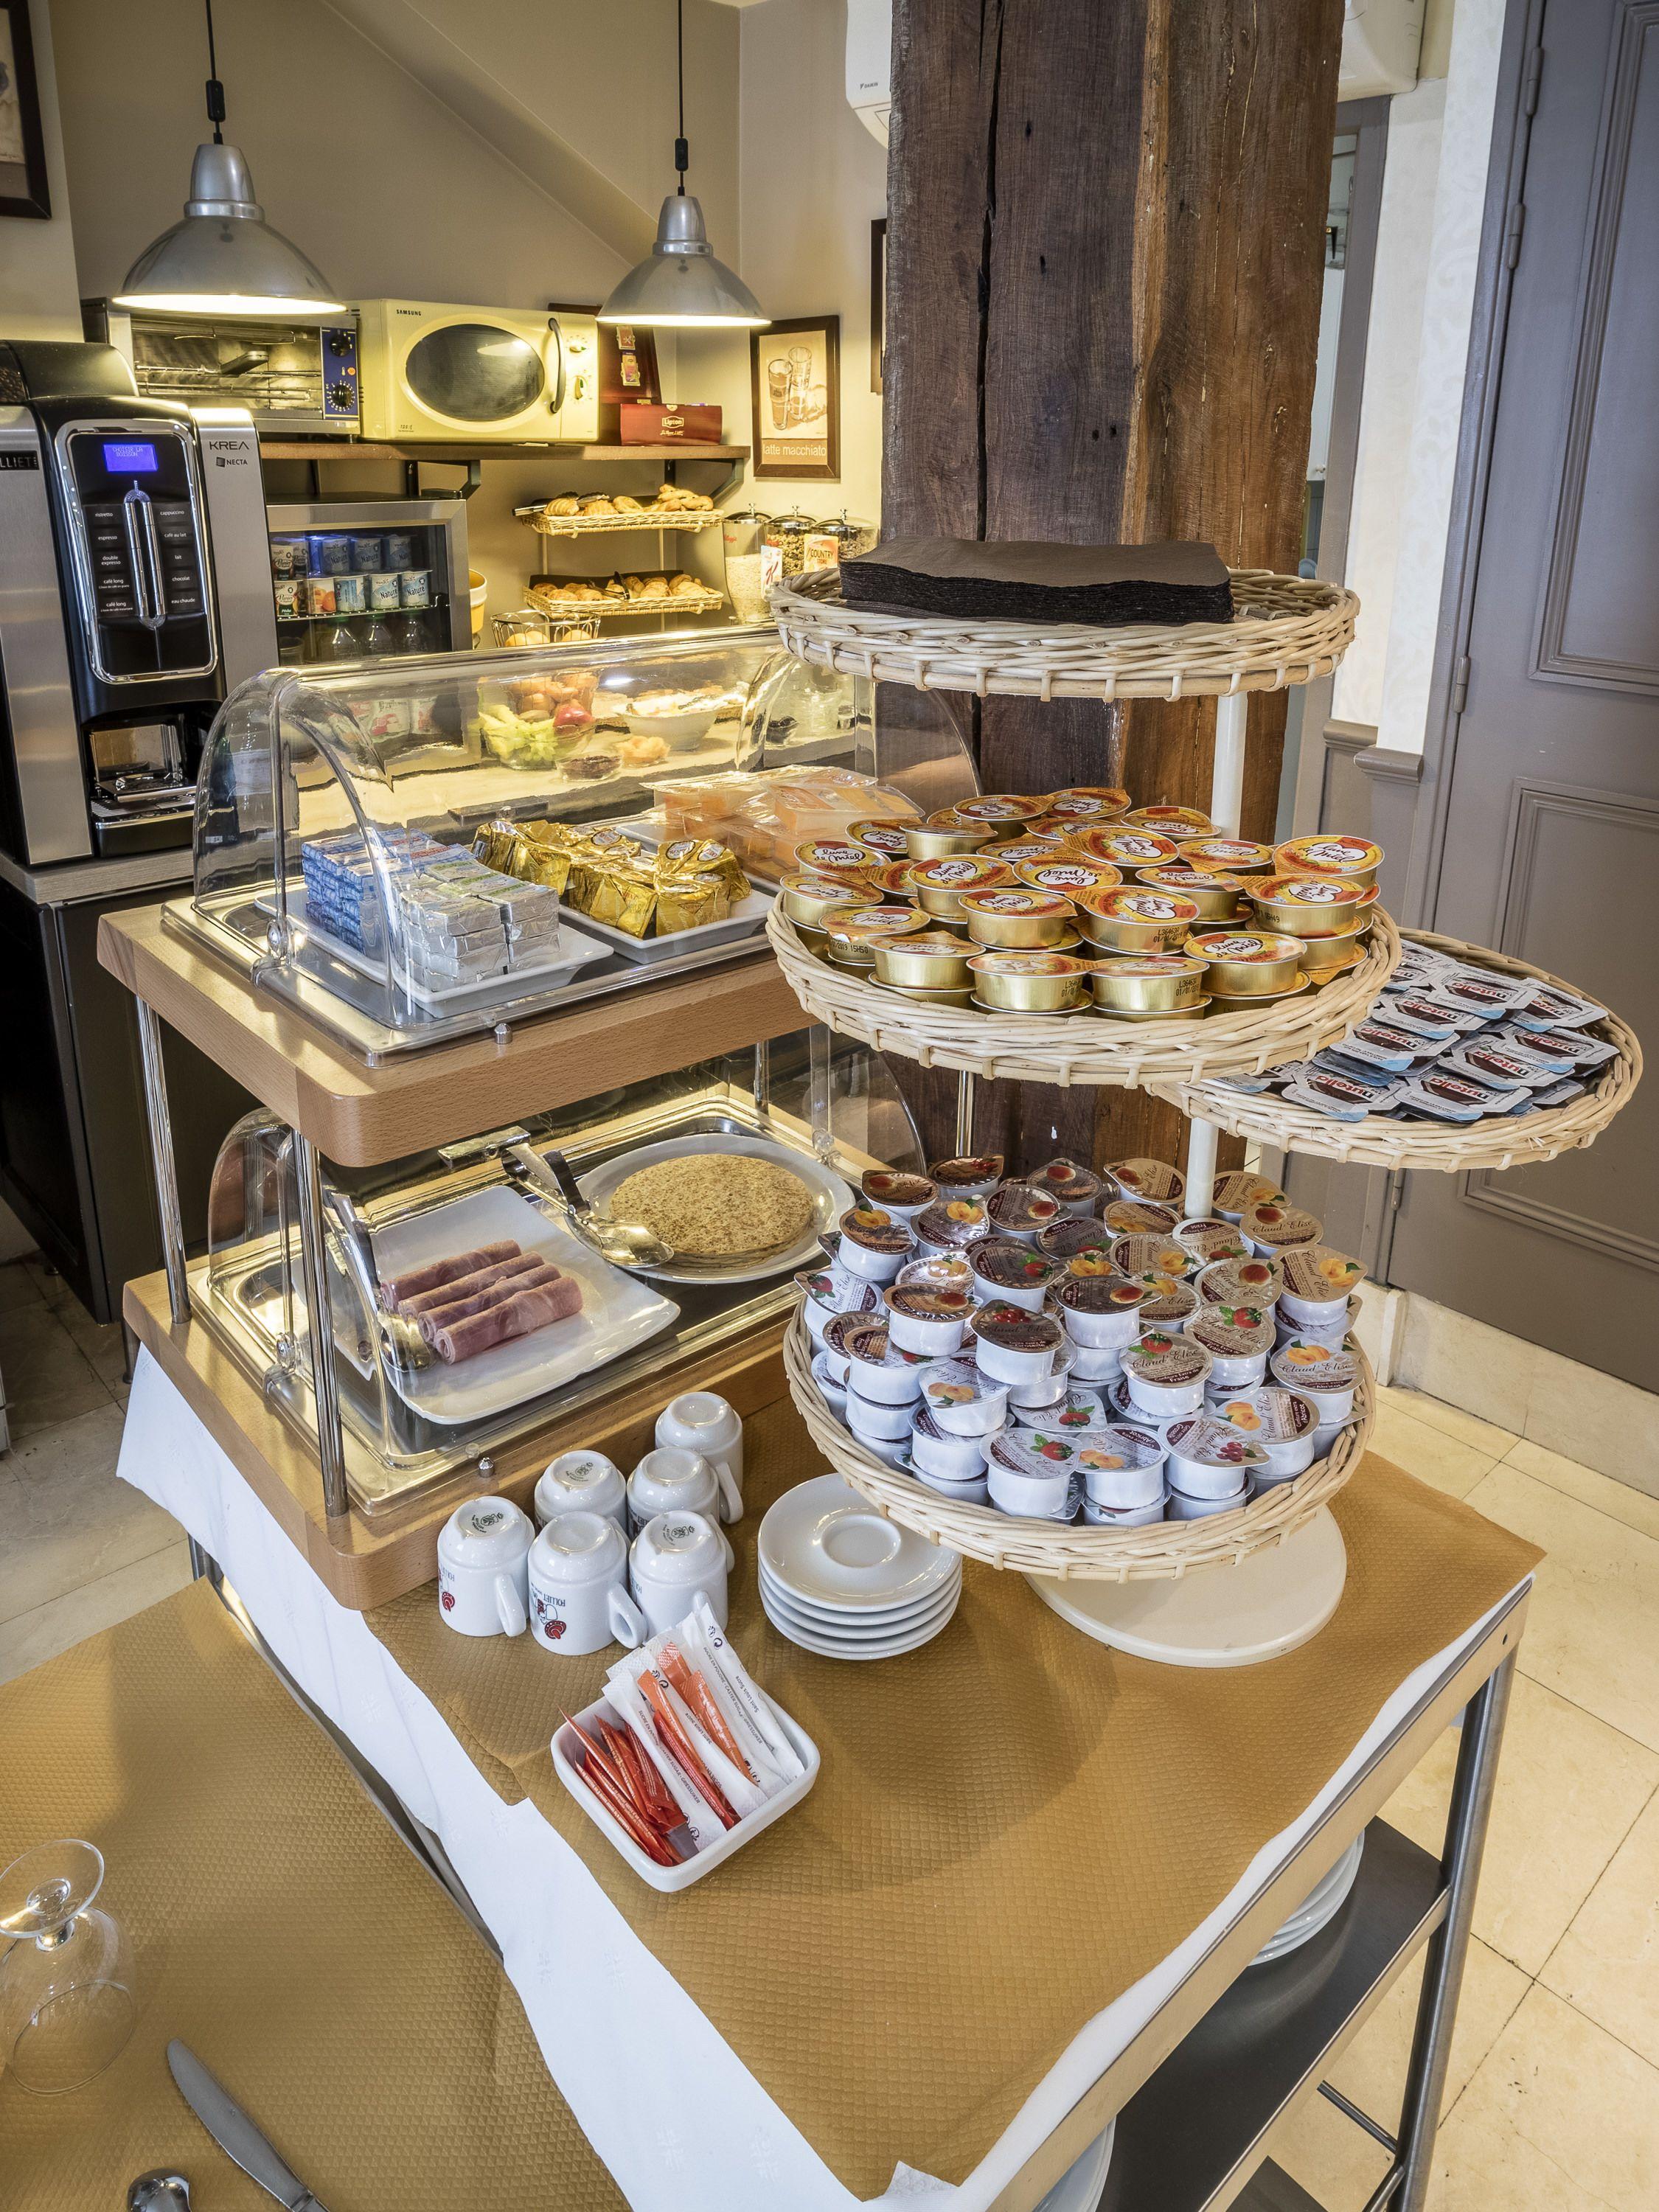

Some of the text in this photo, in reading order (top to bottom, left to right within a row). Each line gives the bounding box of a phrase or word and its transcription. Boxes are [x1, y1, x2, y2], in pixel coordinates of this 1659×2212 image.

[664, 418, 682, 426] Lipton
[209, 441, 249, 451] KREA
[763, 443, 826, 456] latte macchiato
[361, 554, 379, 565] Nature
[810, 549, 834, 559] COUNTRY
[380, 589, 399, 599] Nature
[406, 586, 425, 597] Nature
[851, 945, 869, 954] 15H50
[1452, 982, 1507, 999] nutella
[1403, 1000, 1457, 1020] nutella
[1531, 999, 1565, 1016] nute
[1361, 1026, 1418, 1048] nutella
[1525, 1032, 1581, 1054] nutella
[1475, 1050, 1529, 1076] nutella
[1315, 1074, 1374, 1099] nutella
[1430, 1077, 1489, 1100] nutella
[1249, 1220, 1313, 1234] Claud' Elise
[1129, 1349, 1199, 1369] Claud' Elise
[1277, 1363, 1320, 1373] Claud'
[1169, 1375, 1190, 1383] Fraise
[543, 1593, 566, 1607] FOLLIET
[712, 1665, 727, 1683] POUDRE
[723, 1684, 737, 1702] CASTER
[732, 1674, 760, 1713] Saint Louis Sucre
[669, 1760, 681, 1776] SUGAR
